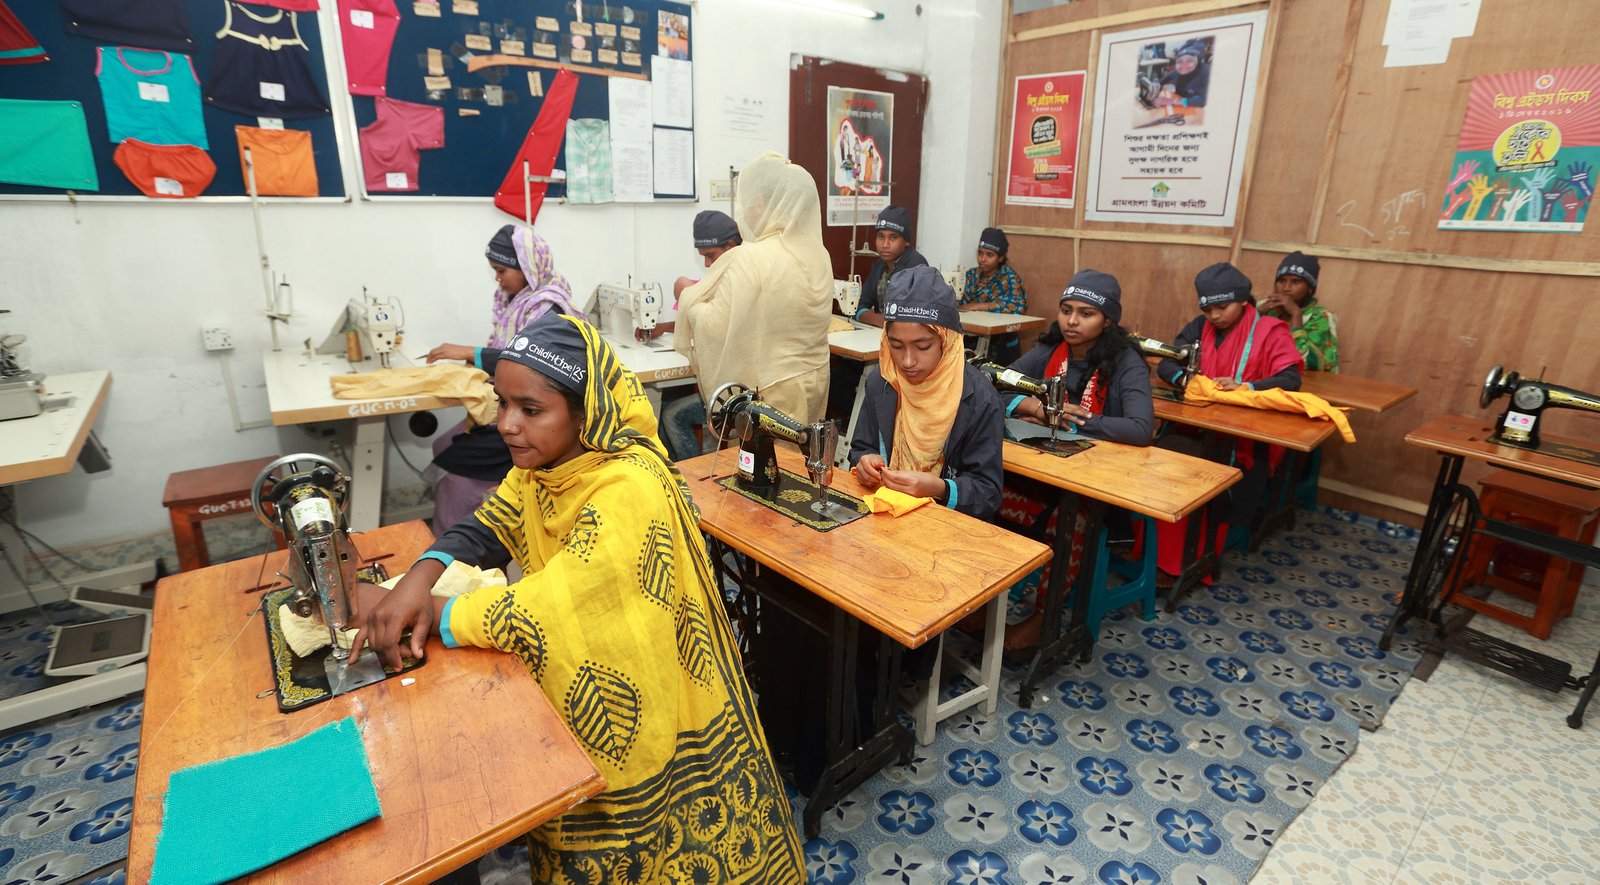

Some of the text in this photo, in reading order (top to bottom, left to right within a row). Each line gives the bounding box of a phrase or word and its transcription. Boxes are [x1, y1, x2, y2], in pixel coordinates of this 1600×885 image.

[1556, 88, 1592, 104] দিবস
[1129, 144, 1200, 153] আগামী দিনের জন্য
[1128, 157, 1147, 165] সুদক্ষ
[1150, 155, 1178, 163] নাগরিক
[1140, 167, 1166, 175] সহায়ক
[1111, 199, 1207, 209] গ্রামবাংলা উন্নয়ন কমিটি
[898, 305, 930, 316] ChildHope
[528, 343, 573, 373] ChildHope
[573, 366, 586, 381] 25
